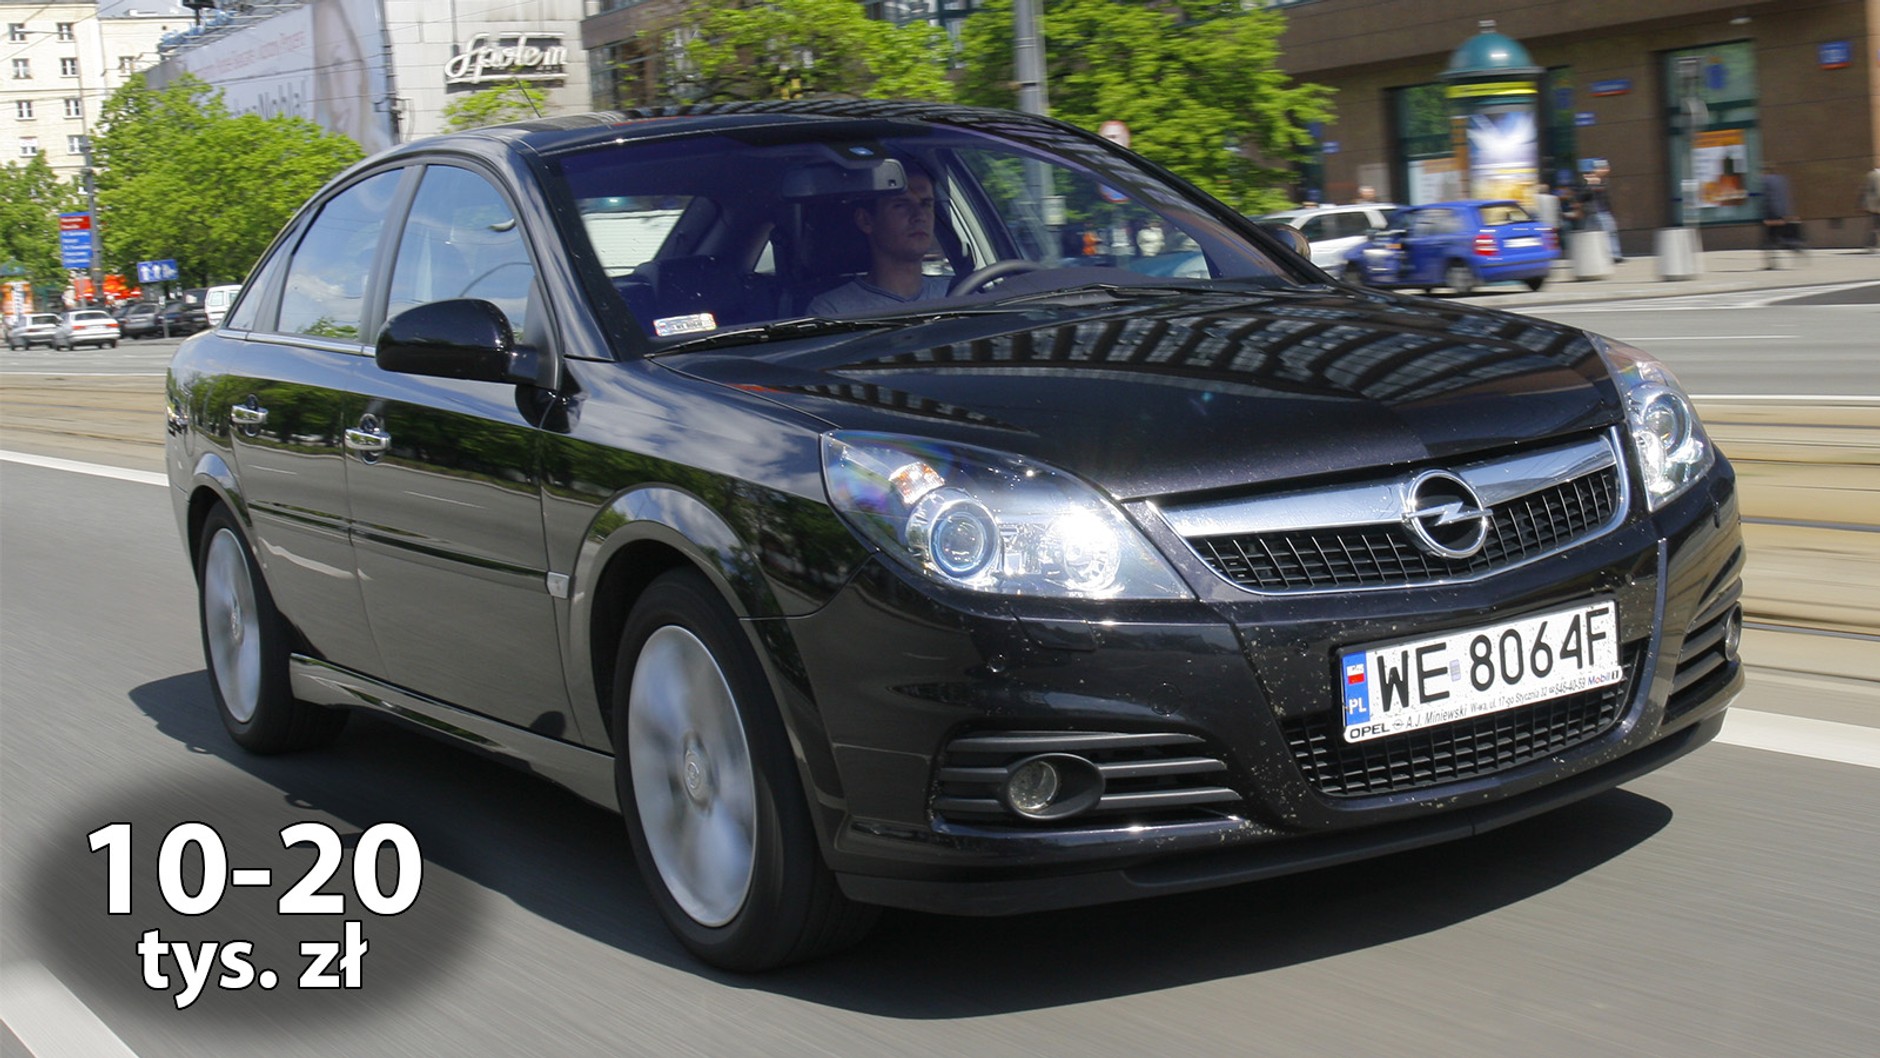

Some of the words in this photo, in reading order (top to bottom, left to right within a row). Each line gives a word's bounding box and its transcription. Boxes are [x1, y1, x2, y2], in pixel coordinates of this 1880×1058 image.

[1376, 641, 1450, 713] WE
[1469, 607, 1610, 692] 8064F
[1348, 697, 1367, 715] PL
[1350, 723, 1390, 739] OPEL
[1588, 674, 1611, 686] Mobil
